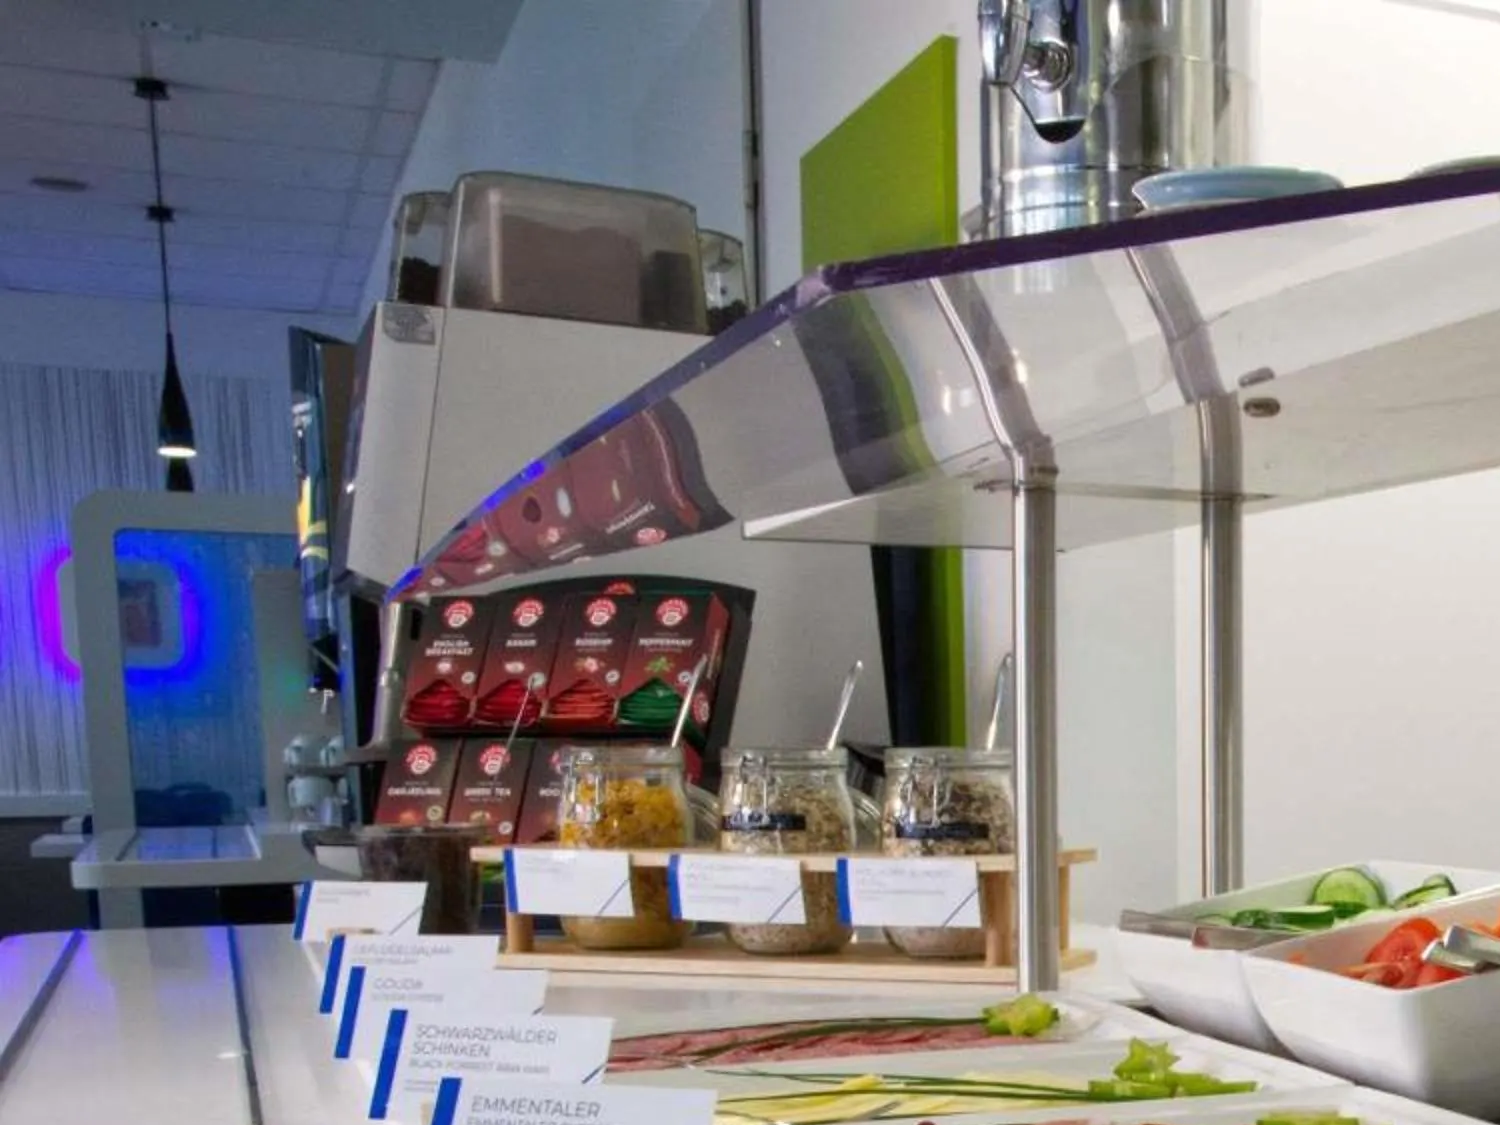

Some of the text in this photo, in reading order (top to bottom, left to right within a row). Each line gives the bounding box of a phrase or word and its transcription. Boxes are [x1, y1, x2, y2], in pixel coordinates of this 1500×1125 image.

[415, 1023, 558, 1044] SCHWARZWÄLDER
[412, 1041, 491, 1057] SCHINKEN
[471, 1095, 600, 1118] EMMENTALER
